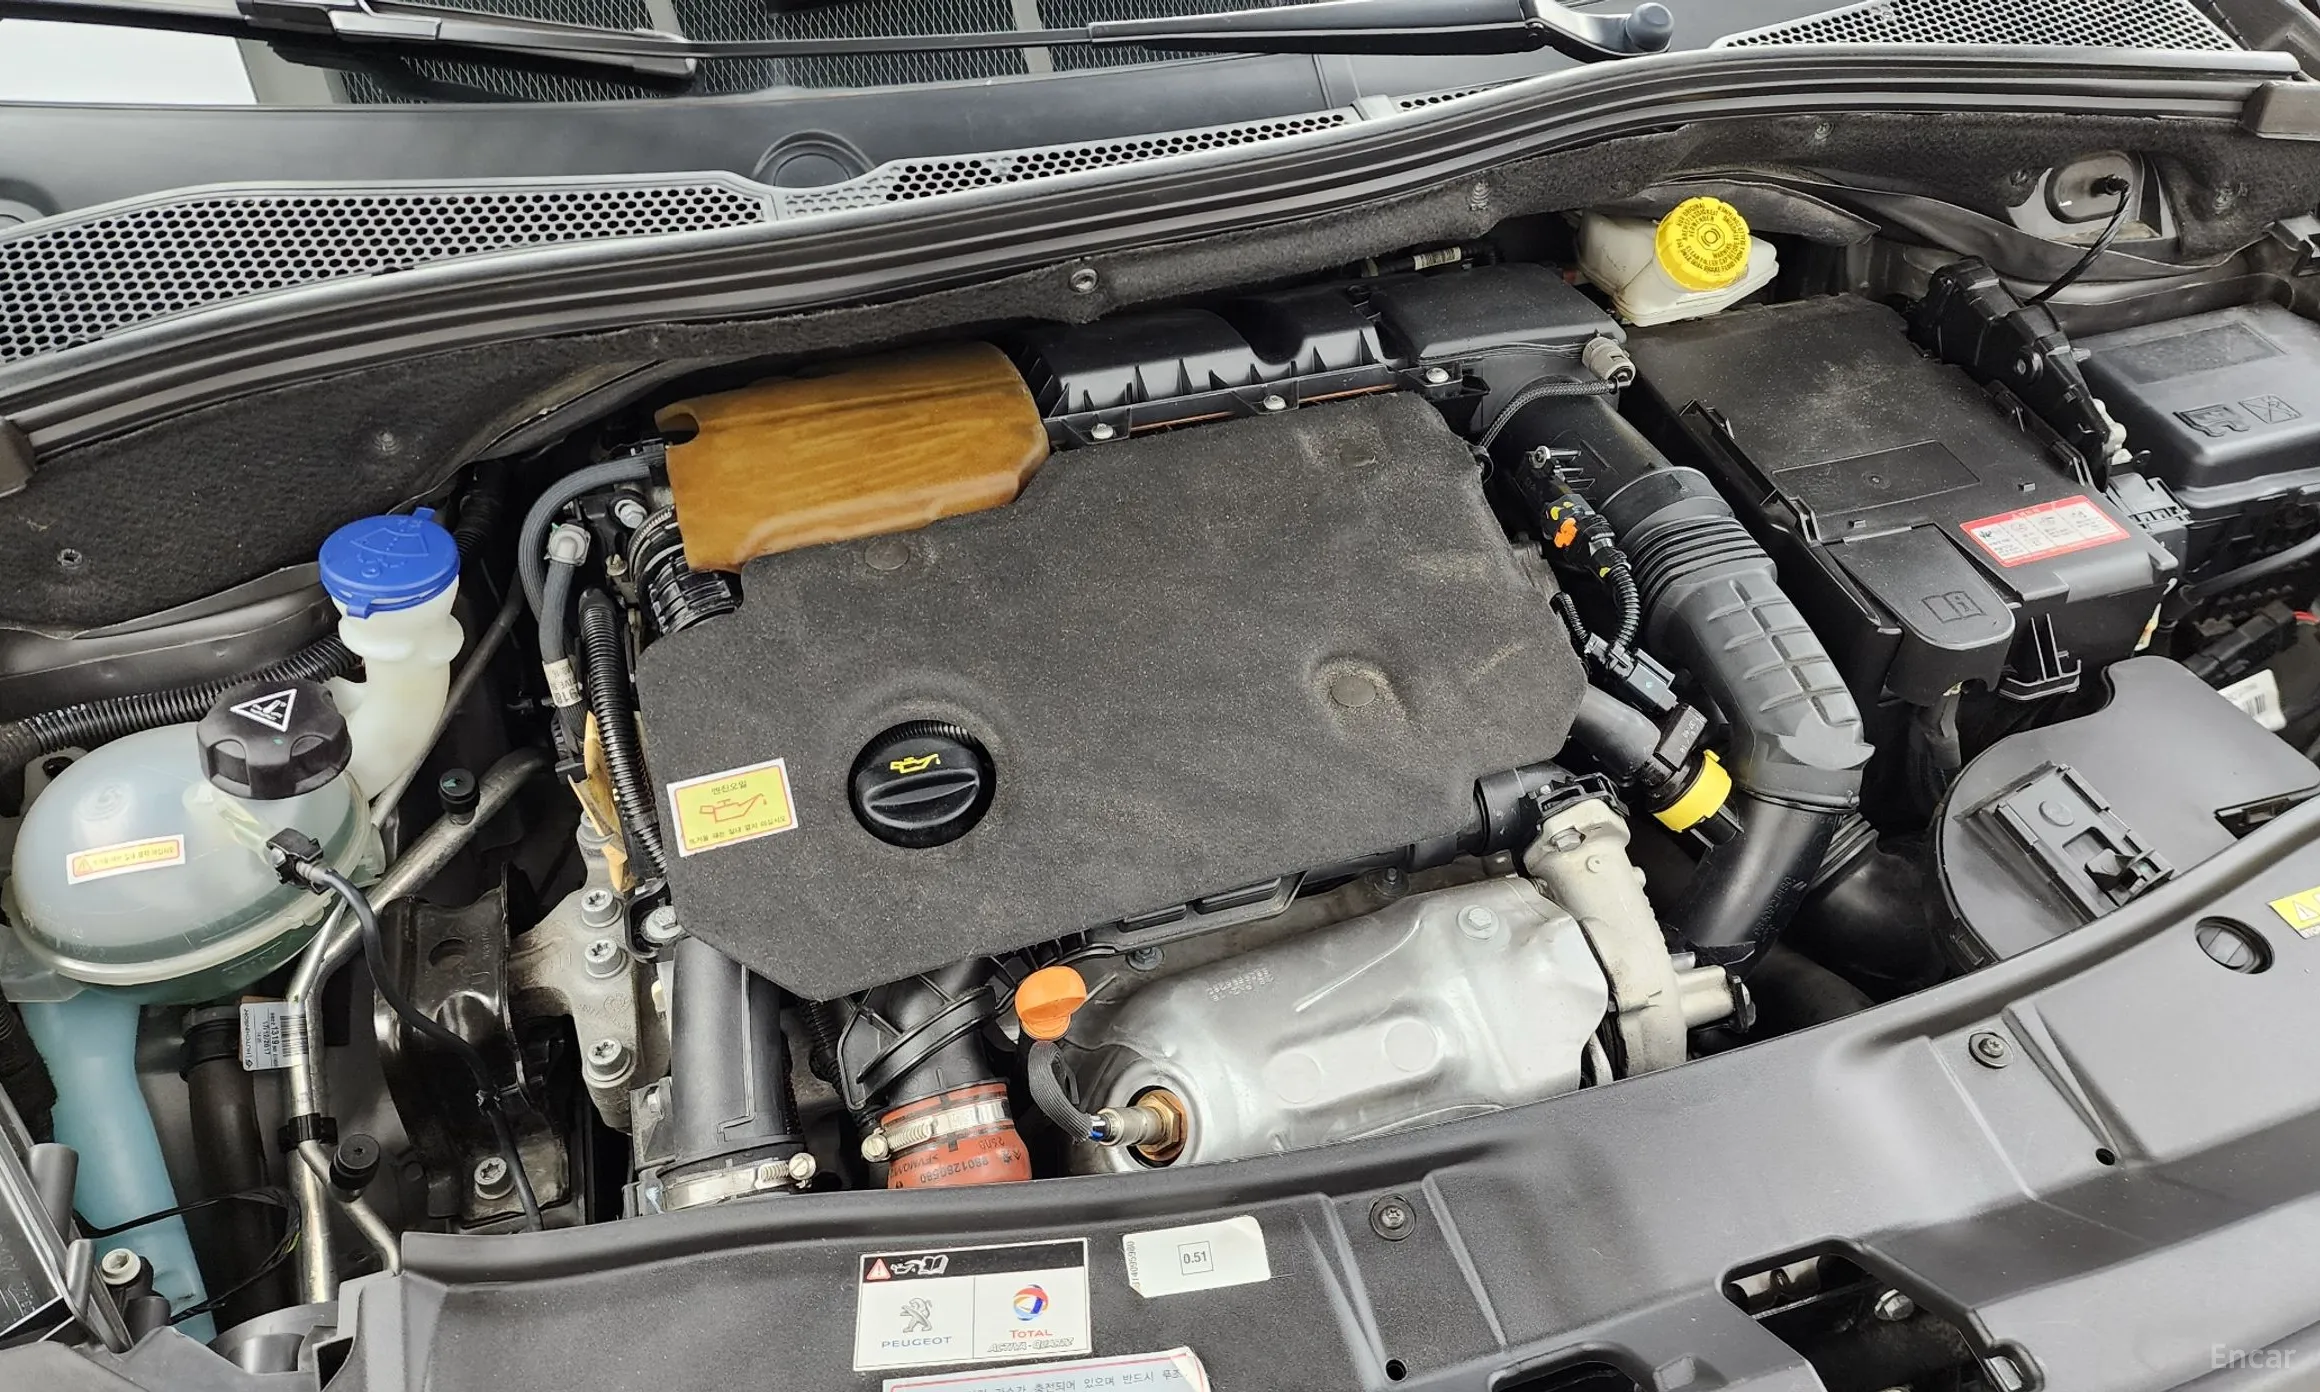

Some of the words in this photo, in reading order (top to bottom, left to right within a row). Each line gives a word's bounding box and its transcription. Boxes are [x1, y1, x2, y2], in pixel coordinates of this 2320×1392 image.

[1183, 1251, 1208, 1265] 0.51
[1009, 1329, 1054, 1339] TOTAL
[881, 1336, 952, 1349] PEUGEOT
[1084, 1374, 1116, 1389] 있으며
[1122, 1370, 1155, 1385] 반드시
